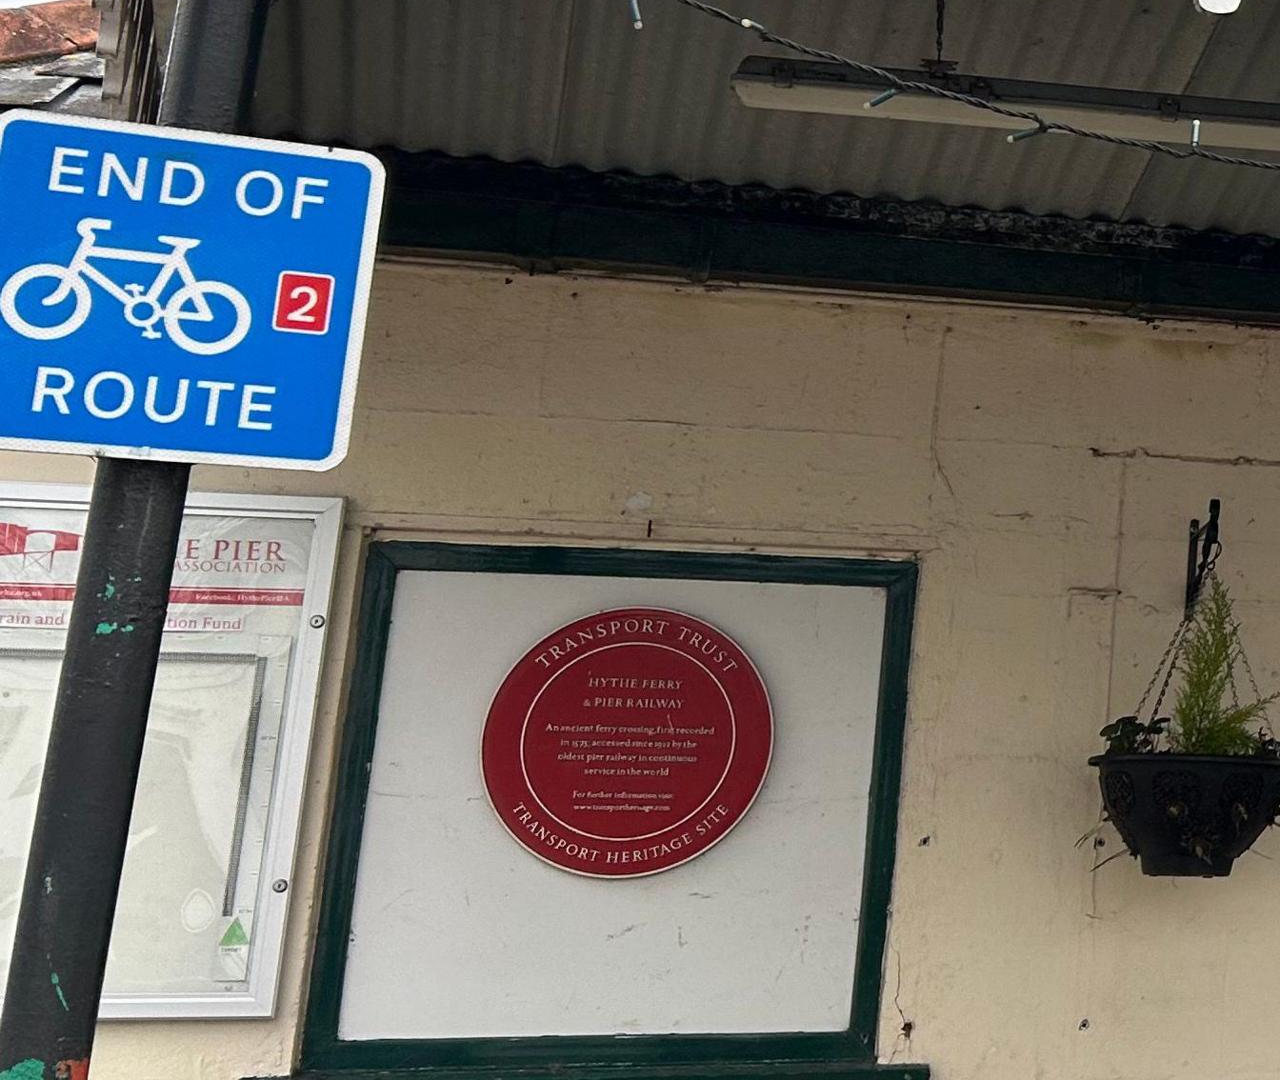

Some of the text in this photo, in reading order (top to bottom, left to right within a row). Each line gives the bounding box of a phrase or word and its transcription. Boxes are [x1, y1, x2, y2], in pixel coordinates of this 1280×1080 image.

[48, 146, 329, 220] END OF
[287, 286, 319, 322] 2
[31, 366, 277, 431] ROUTE
[213, 540, 287, 562] PIER
[174, 560, 287, 574] ASSOCIATION
[34, 612, 65, 626] and
[202, 617, 243, 630] Fund
[534, 618, 739, 672] TRANSPORT TRUST
[588, 678, 683, 690] HYTHE FERRY
[583, 697, 684, 710] & PIER RAILWAY
[545, 722, 560, 732] An
[560, 724, 595, 733] ancient
[595, 724, 617, 735] ferry
[676, 726, 716, 736] recorded
[672, 739, 683, 750] by
[683, 740, 698, 749] the
[557, 752, 585, 762] oldest
[586, 753, 605, 764] pier
[605, 752, 638, 763] railway
[648, 754, 699, 764] continuous
[583, 766, 671, 778] service in the world
[511, 800, 730, 864] TRANSPORT HERITAGE SITE
